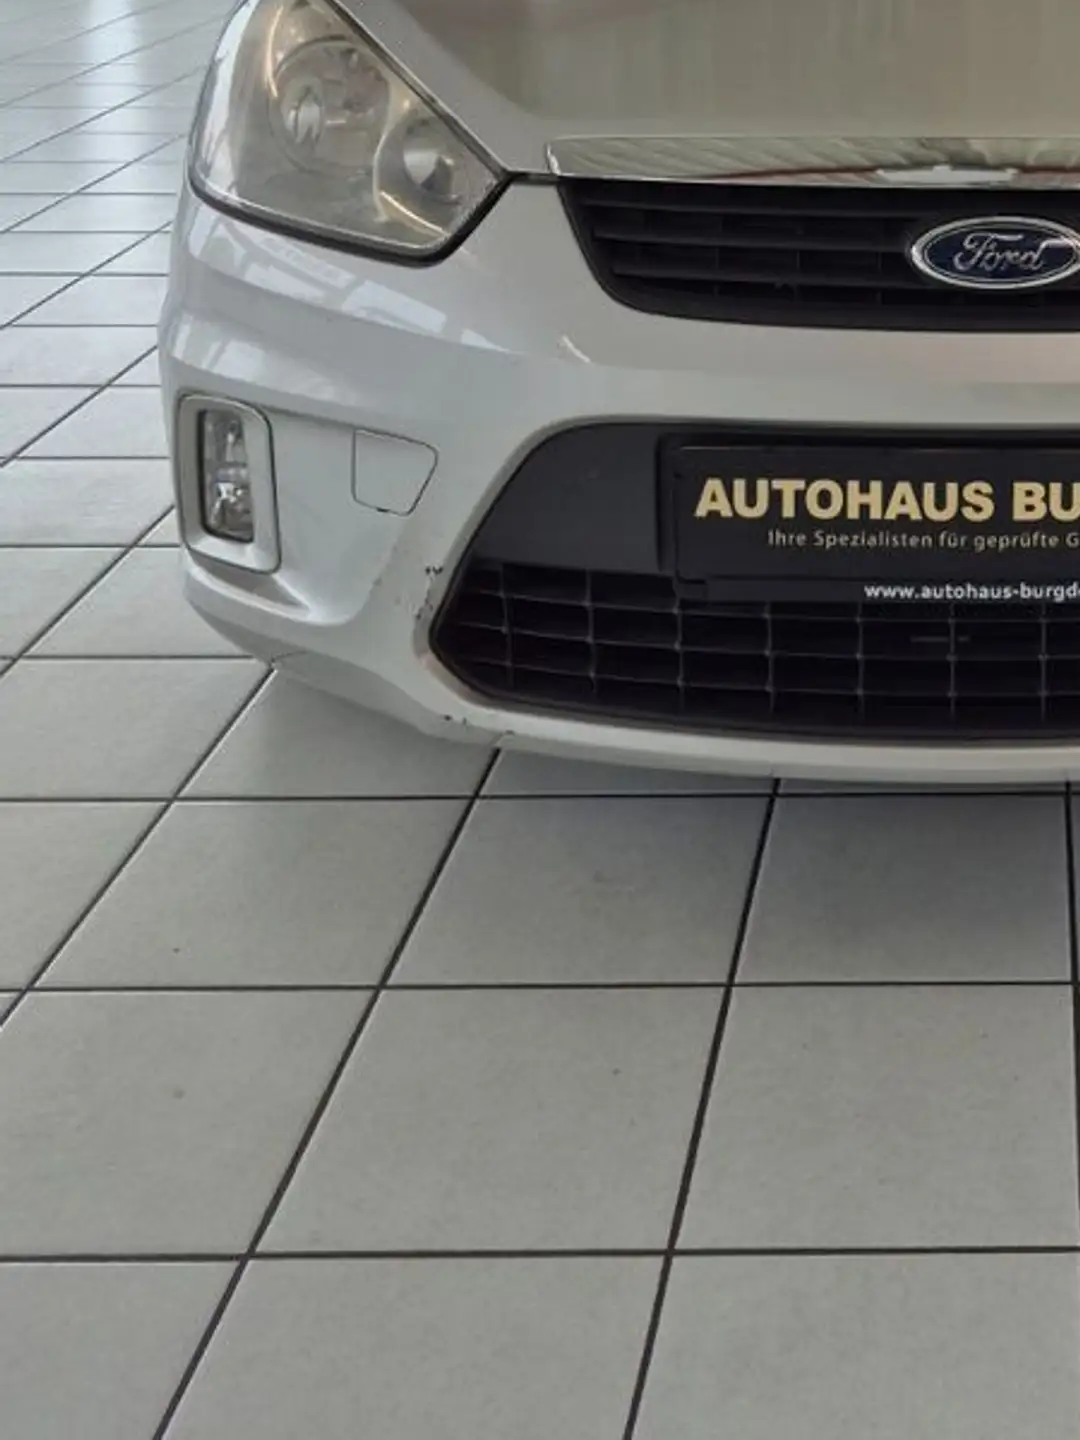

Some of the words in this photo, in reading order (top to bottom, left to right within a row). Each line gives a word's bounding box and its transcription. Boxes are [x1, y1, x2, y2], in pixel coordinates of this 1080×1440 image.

[954, 232, 1076, 271] Ford
[694, 477, 996, 522] AUTOHAUS
[767, 529, 807, 547] Ihre
[814, 529, 933, 550] Spezialisten
[938, 529, 967, 548] für
[973, 530, 1060, 552] geprüfte
